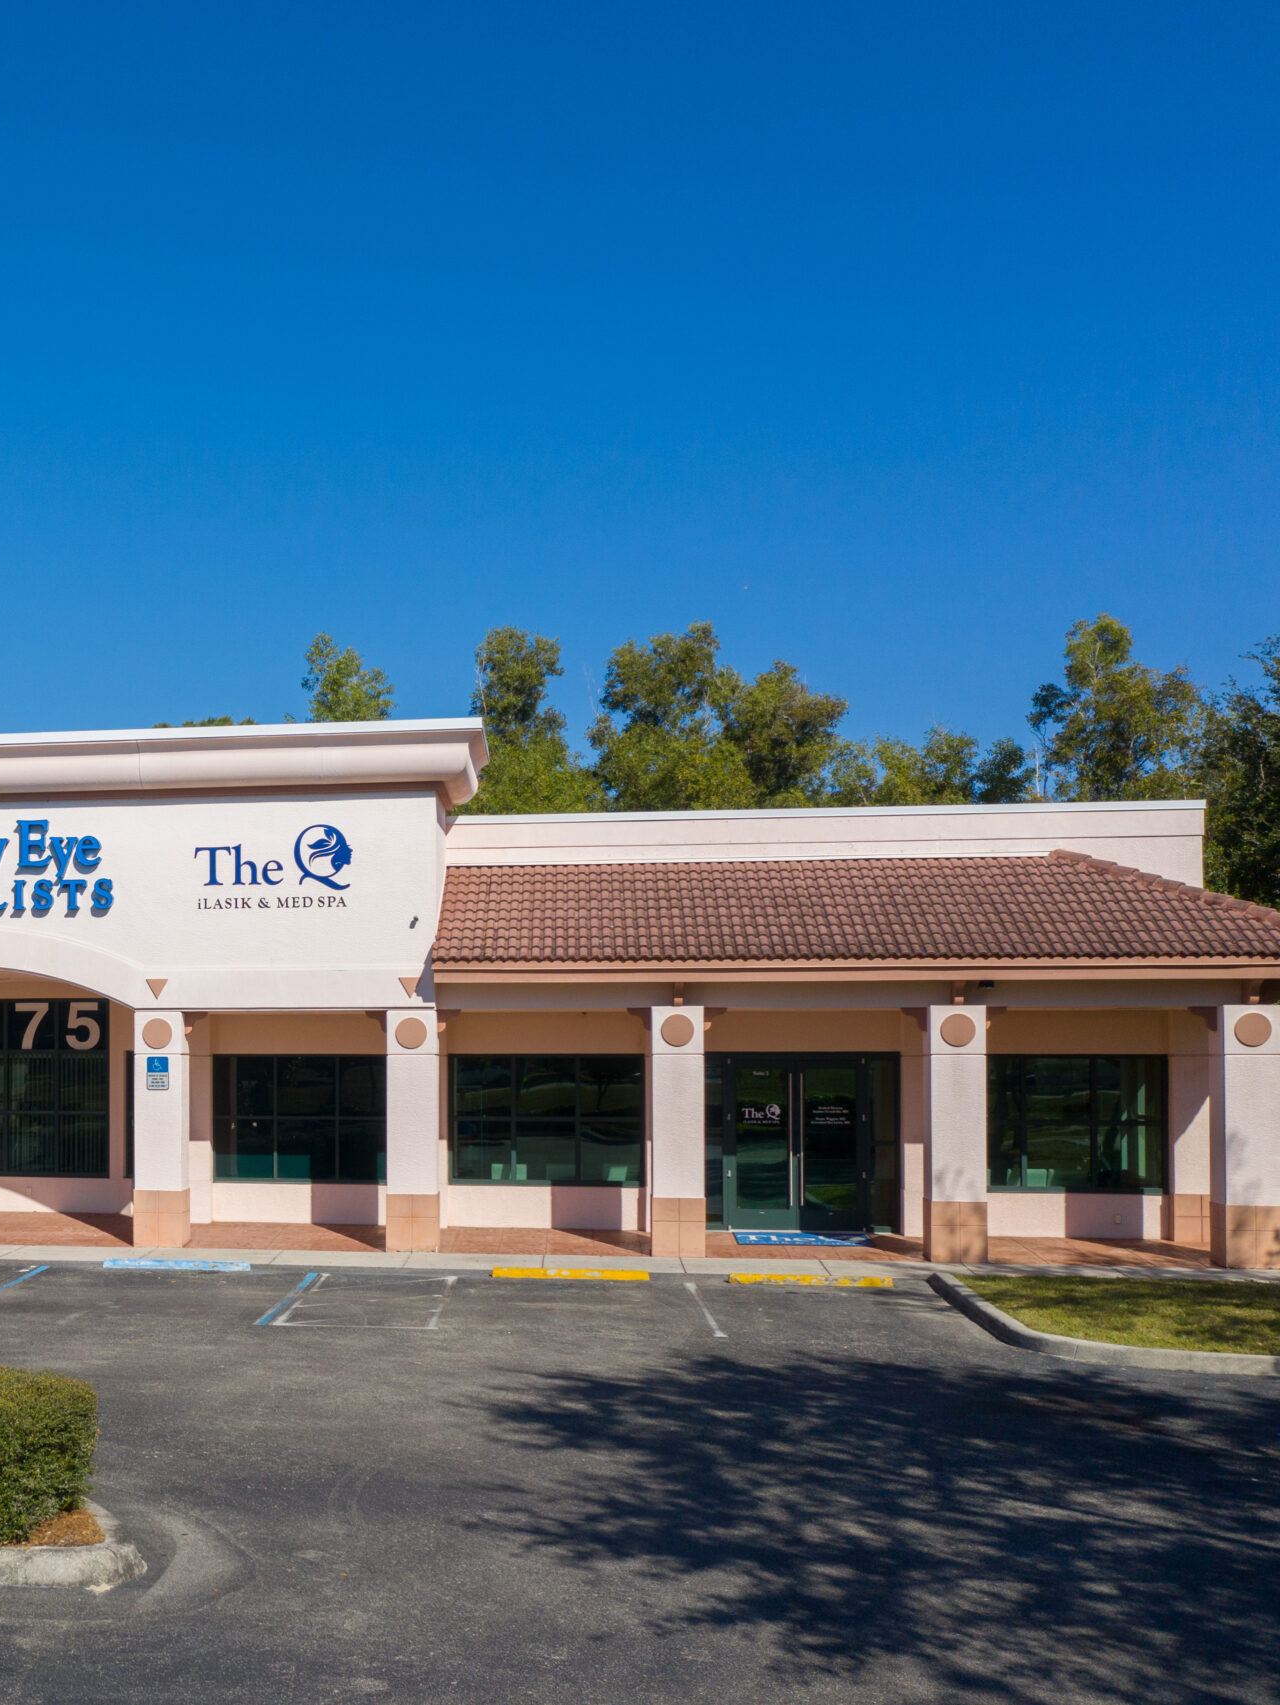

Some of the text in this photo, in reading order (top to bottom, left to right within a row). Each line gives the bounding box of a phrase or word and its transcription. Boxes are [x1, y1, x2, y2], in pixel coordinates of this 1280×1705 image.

[16, 819, 102, 878] Eye
[194, 824, 353, 890] The Q
[197, 895, 347, 909] iLASIK & MED SPA
[741, 1108, 764, 1118] The
